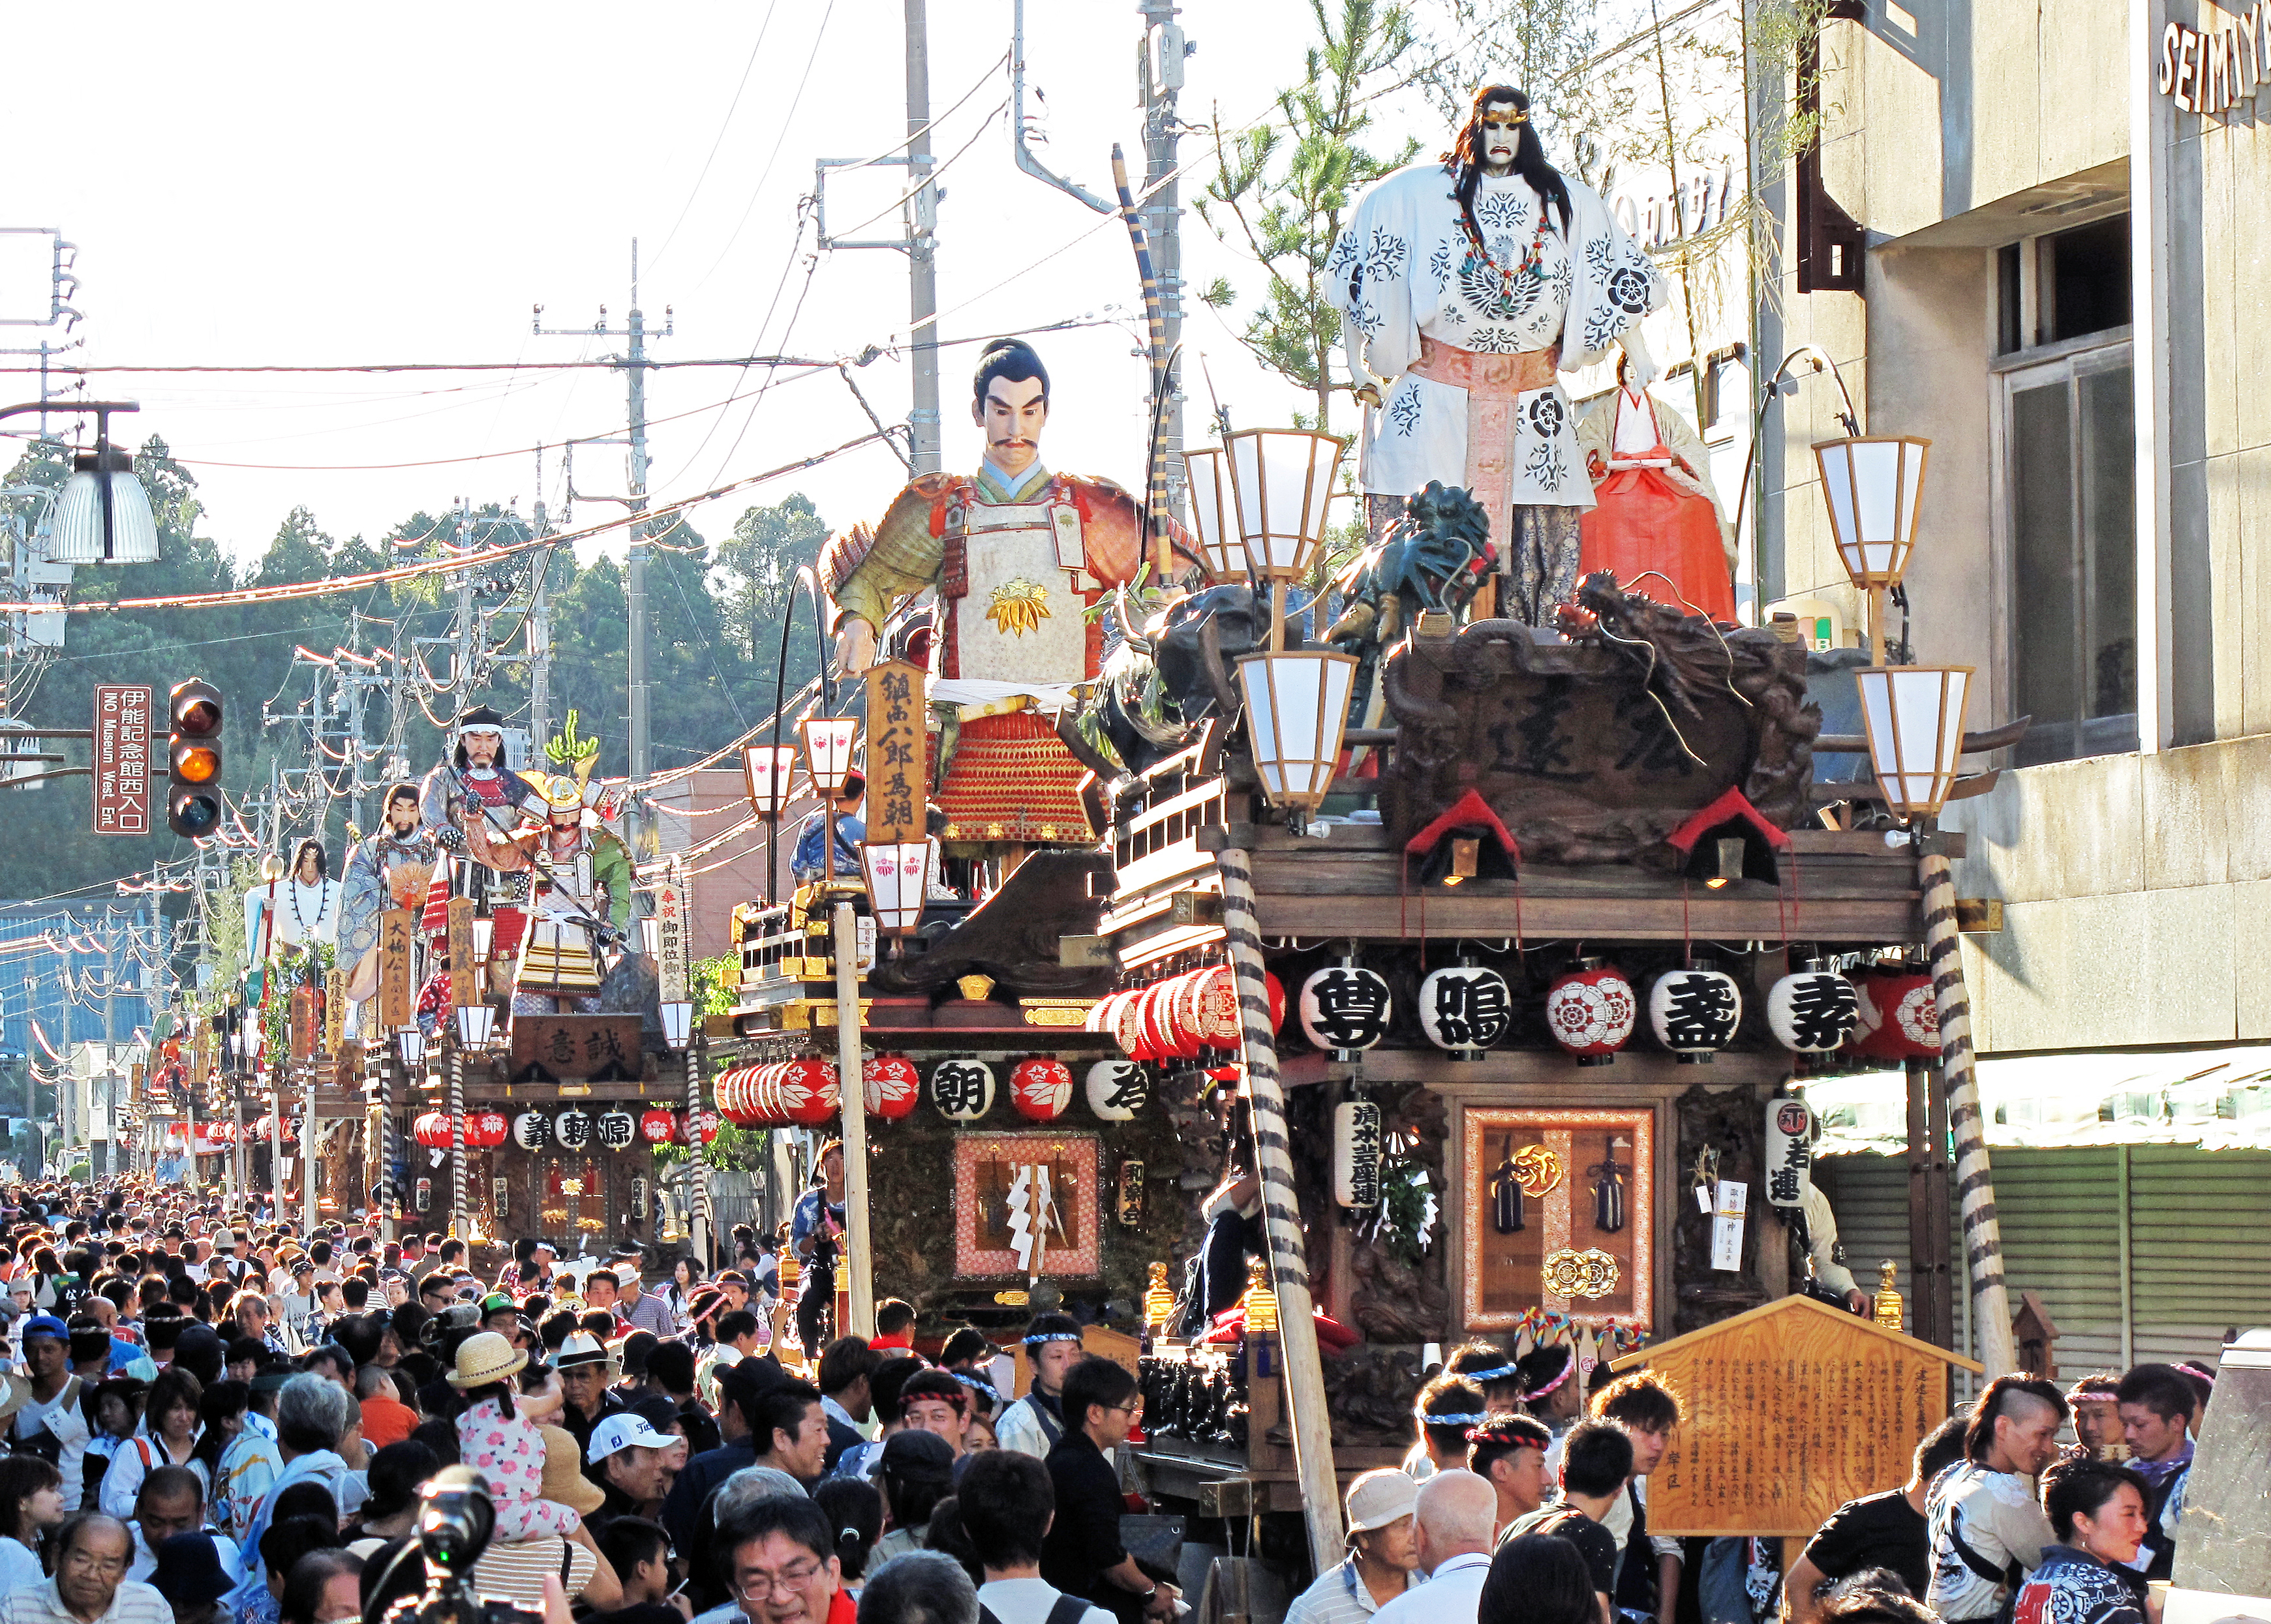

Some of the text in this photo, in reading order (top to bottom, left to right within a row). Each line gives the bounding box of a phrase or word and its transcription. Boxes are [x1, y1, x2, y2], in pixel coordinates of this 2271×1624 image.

[103, 692, 118, 712] INO
[102, 719, 117, 764] Museum
[117, 690, 146, 830] 伊能記念館西入口
[102, 771, 116, 800] West
[1311, 969, 1390, 1047] 尊
[936, 1063, 986, 1115] 朝
[524, 1115, 551, 1147] 義
[598, 1115, 630, 1145] 源
[1727, 1188, 1739, 1232] 諏訪神
